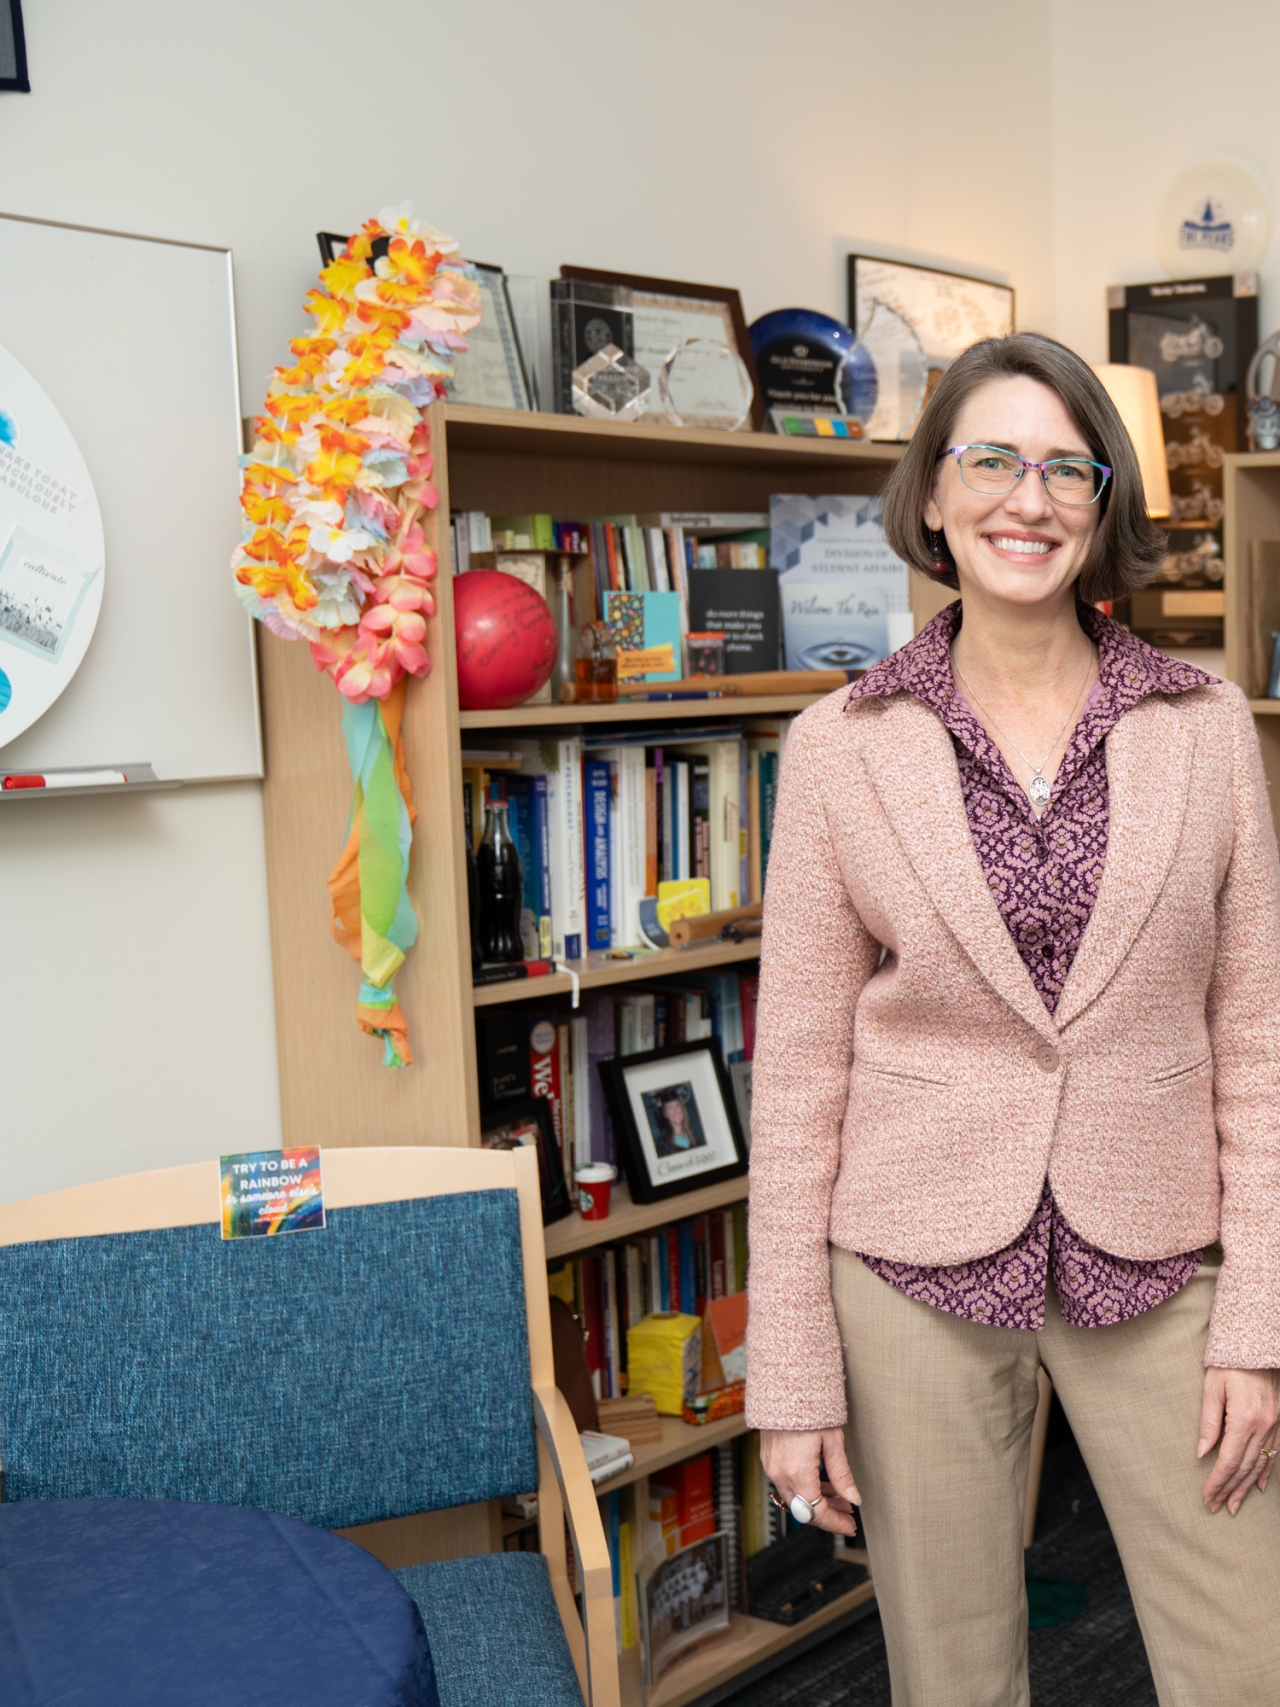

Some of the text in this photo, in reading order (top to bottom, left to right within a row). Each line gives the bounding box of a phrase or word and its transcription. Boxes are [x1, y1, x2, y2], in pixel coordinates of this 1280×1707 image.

[0, 458, 76, 513] DICULOUSLY
[34, 468, 78, 500] TODAY
[0, 474, 58, 515] ABULOUS
[825, 549, 873, 559] DIVISION
[811, 564, 904, 574] STUDENT AFFAIRS
[791, 594, 832, 616] Welcome
[835, 592, 853, 616] The
[739, 609, 764, 620] things
[706, 620, 761, 632] that make you
[593, 790, 607, 825] DESIGN
[594, 837, 608, 881] ANALYSIS
[232, 1157, 309, 1175] TRY TO BE A
[657, 1161, 682, 1177] Class
[240, 1174, 303, 1190] RAINBOW
[239, 1191, 288, 1204] someone
